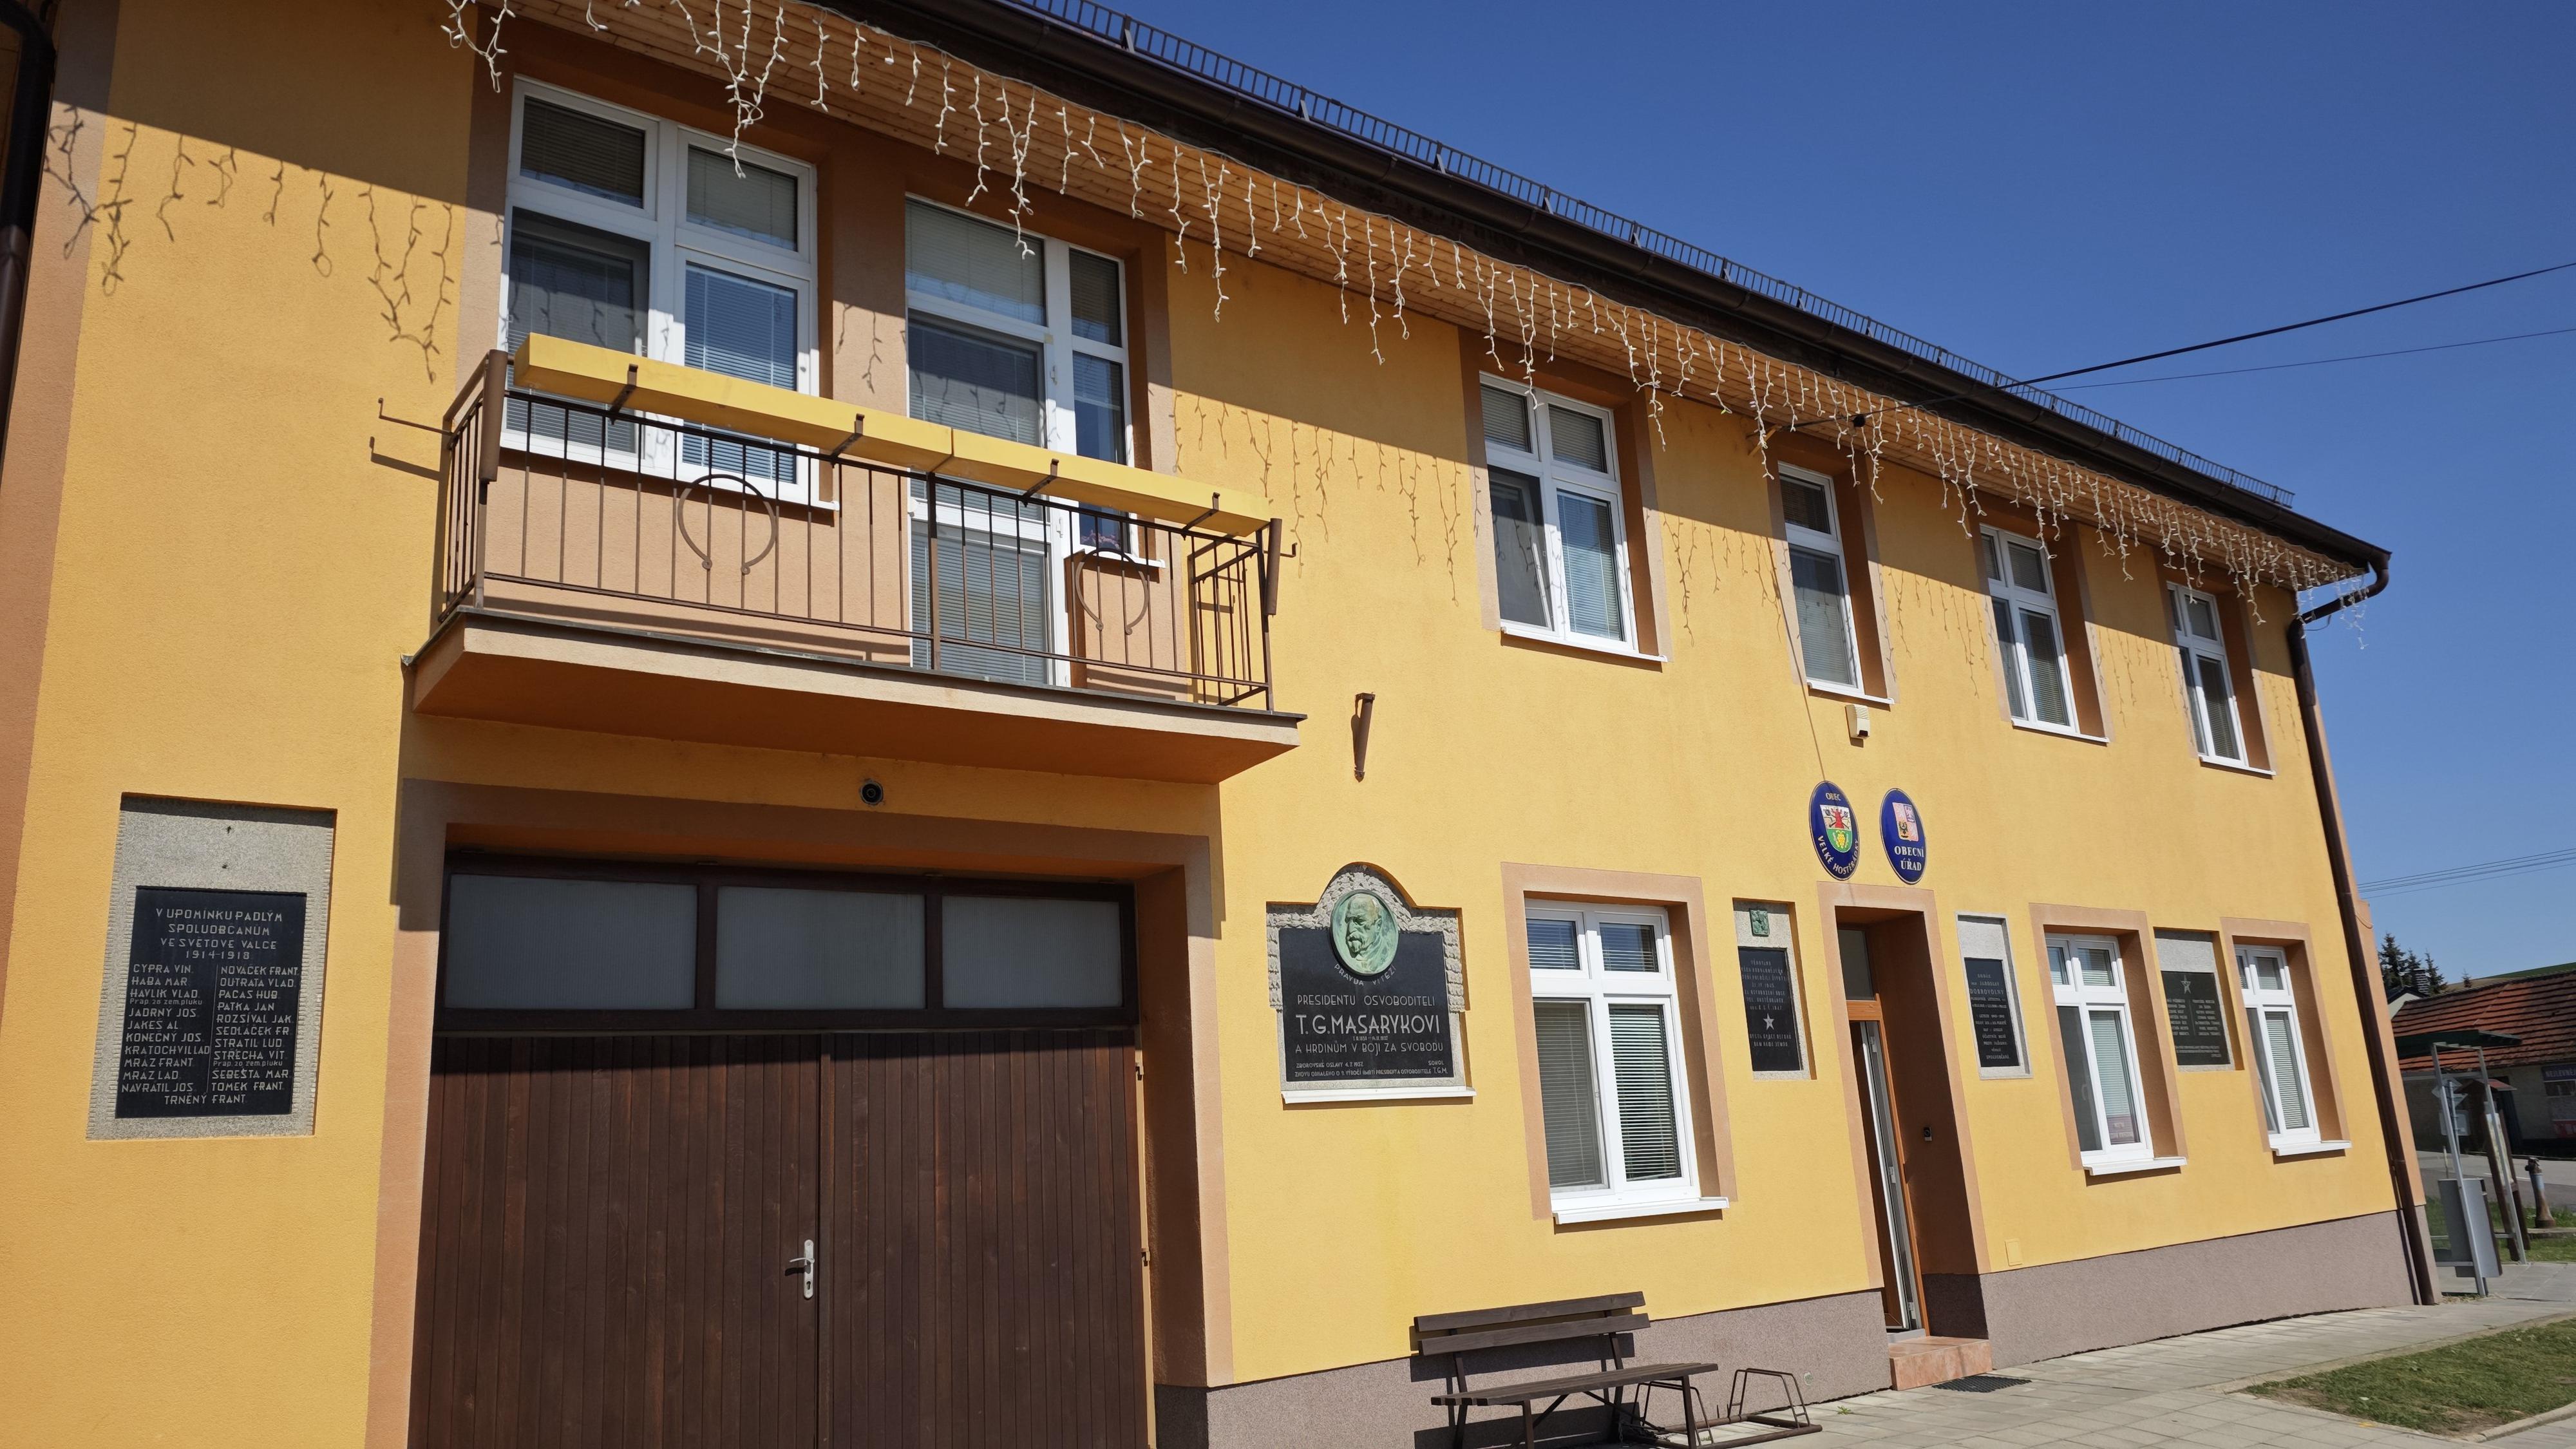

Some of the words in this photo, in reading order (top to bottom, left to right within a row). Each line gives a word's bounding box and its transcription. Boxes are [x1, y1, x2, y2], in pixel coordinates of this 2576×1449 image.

[1825, 793, 1841, 801] OBEC
[1818, 835, 1834, 864] VELKÉ
[1894, 845, 1924, 857] OBECNÍ
[1833, 838, 1859, 875] HOSTĚRÁDKY
[1900, 858, 1922, 871] ÚŘAD
[156, 908, 163, 918] V
[235, 909, 283, 922] PADLÝM
[168, 922, 270, 936] SPOLUOBČANŮM
[160, 938, 175, 947] VE
[186, 950, 250, 960] 1914-1918
[133, 963, 170, 974] CYPRA
[1334, 963, 1364, 987] PRAVDA
[220, 978, 265, 987] OUTRATA
[254, 1002, 274, 1011] JAN
[1297, 995, 1356, 1006] PRESIDENTU
[1364, 995, 1435, 1007] OSVOBODITELI
[126, 1030, 177, 1042] KONEČNÝ
[1295, 1044, 1302, 1054] A
[1305, 1040, 1347, 1054] HRDINŮM
[1351, 1043, 1358, 1053] V
[1362, 1043, 1381, 1056] BOJI
[1384, 1043, 1397, 1052] ZA
[1401, 1042, 1443, 1052] SVOBODU
[211, 1082, 248, 1091] TOMEK
